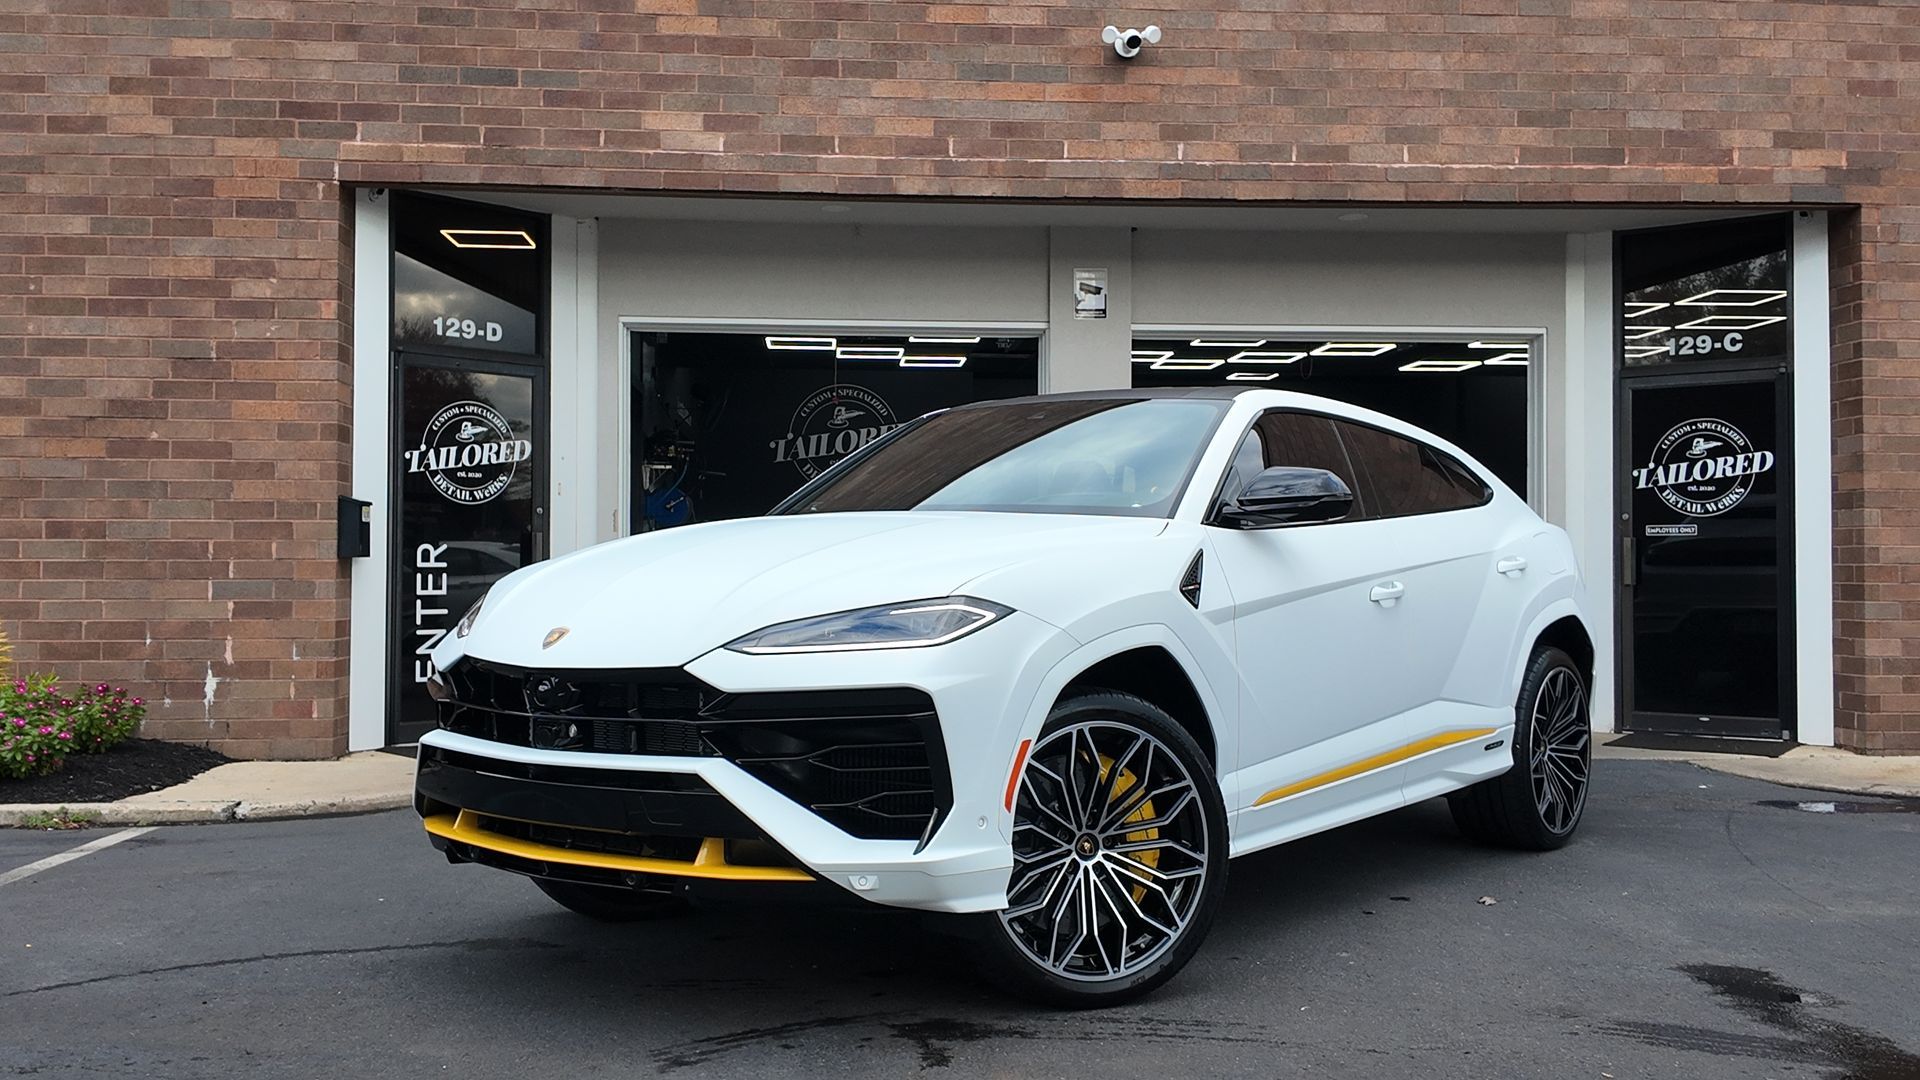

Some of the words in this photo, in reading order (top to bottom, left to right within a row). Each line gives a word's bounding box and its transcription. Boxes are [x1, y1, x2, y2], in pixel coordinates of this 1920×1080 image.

[433, 316, 503, 342] 129-D
[1666, 332, 1743, 356] 129-C
[800, 391, 831, 417] CUSTOM
[838, 388, 888, 416] SPECIALIZED
[432, 407, 460, 431] CUSTOM
[464, 405, 508, 434] SPECIALIZED
[1661, 424, 1691, 450] CUSTOM
[1696, 421, 1745, 447] SPECIALIZED
[404, 439, 532, 473] TAILORED
[1632, 450, 1774, 489] TAILORED
[433, 473, 472, 501] DETAIL
[1662, 488, 1704, 513] DETAIL
[415, 543, 449, 683] ENTER
